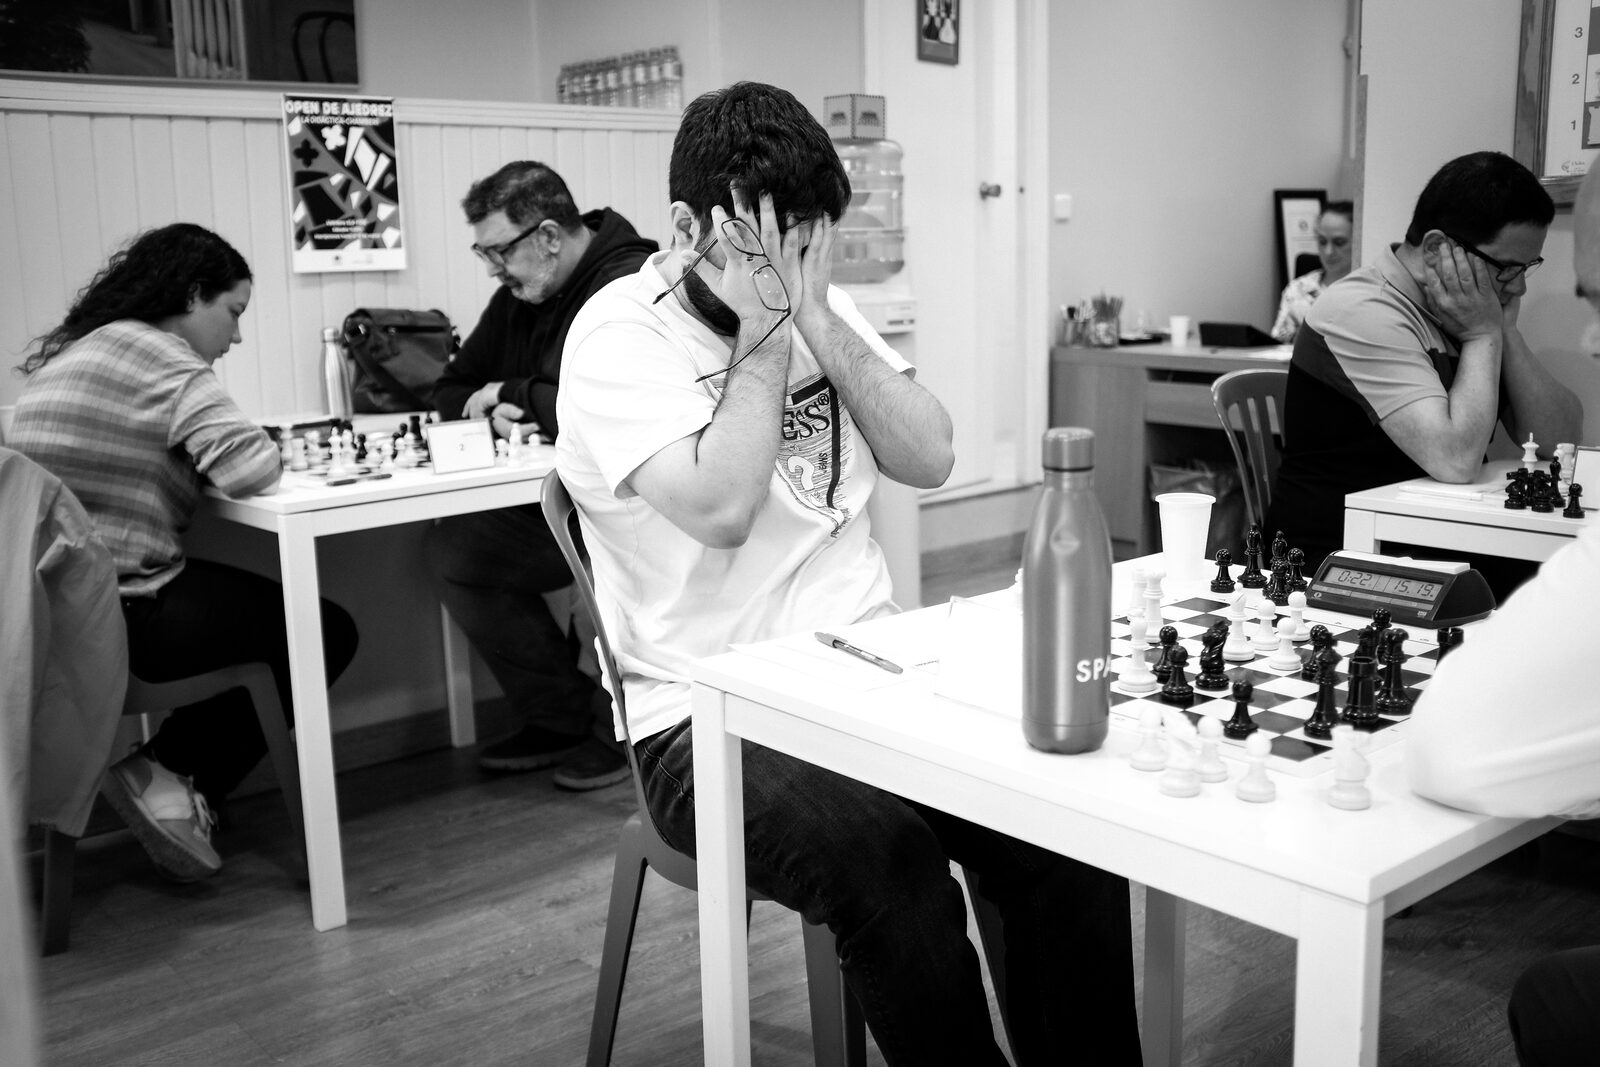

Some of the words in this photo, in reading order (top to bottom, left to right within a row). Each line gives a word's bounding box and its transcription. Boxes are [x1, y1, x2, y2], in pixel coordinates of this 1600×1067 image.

[1574, 27, 1583, 38] 3
[1571, 74, 1580, 85] 2
[285, 100, 319, 114] OPEN
[322, 101, 340, 115] DE
[341, 102, 393, 117] AJEDREZ
[1570, 120, 1577, 130] 1
